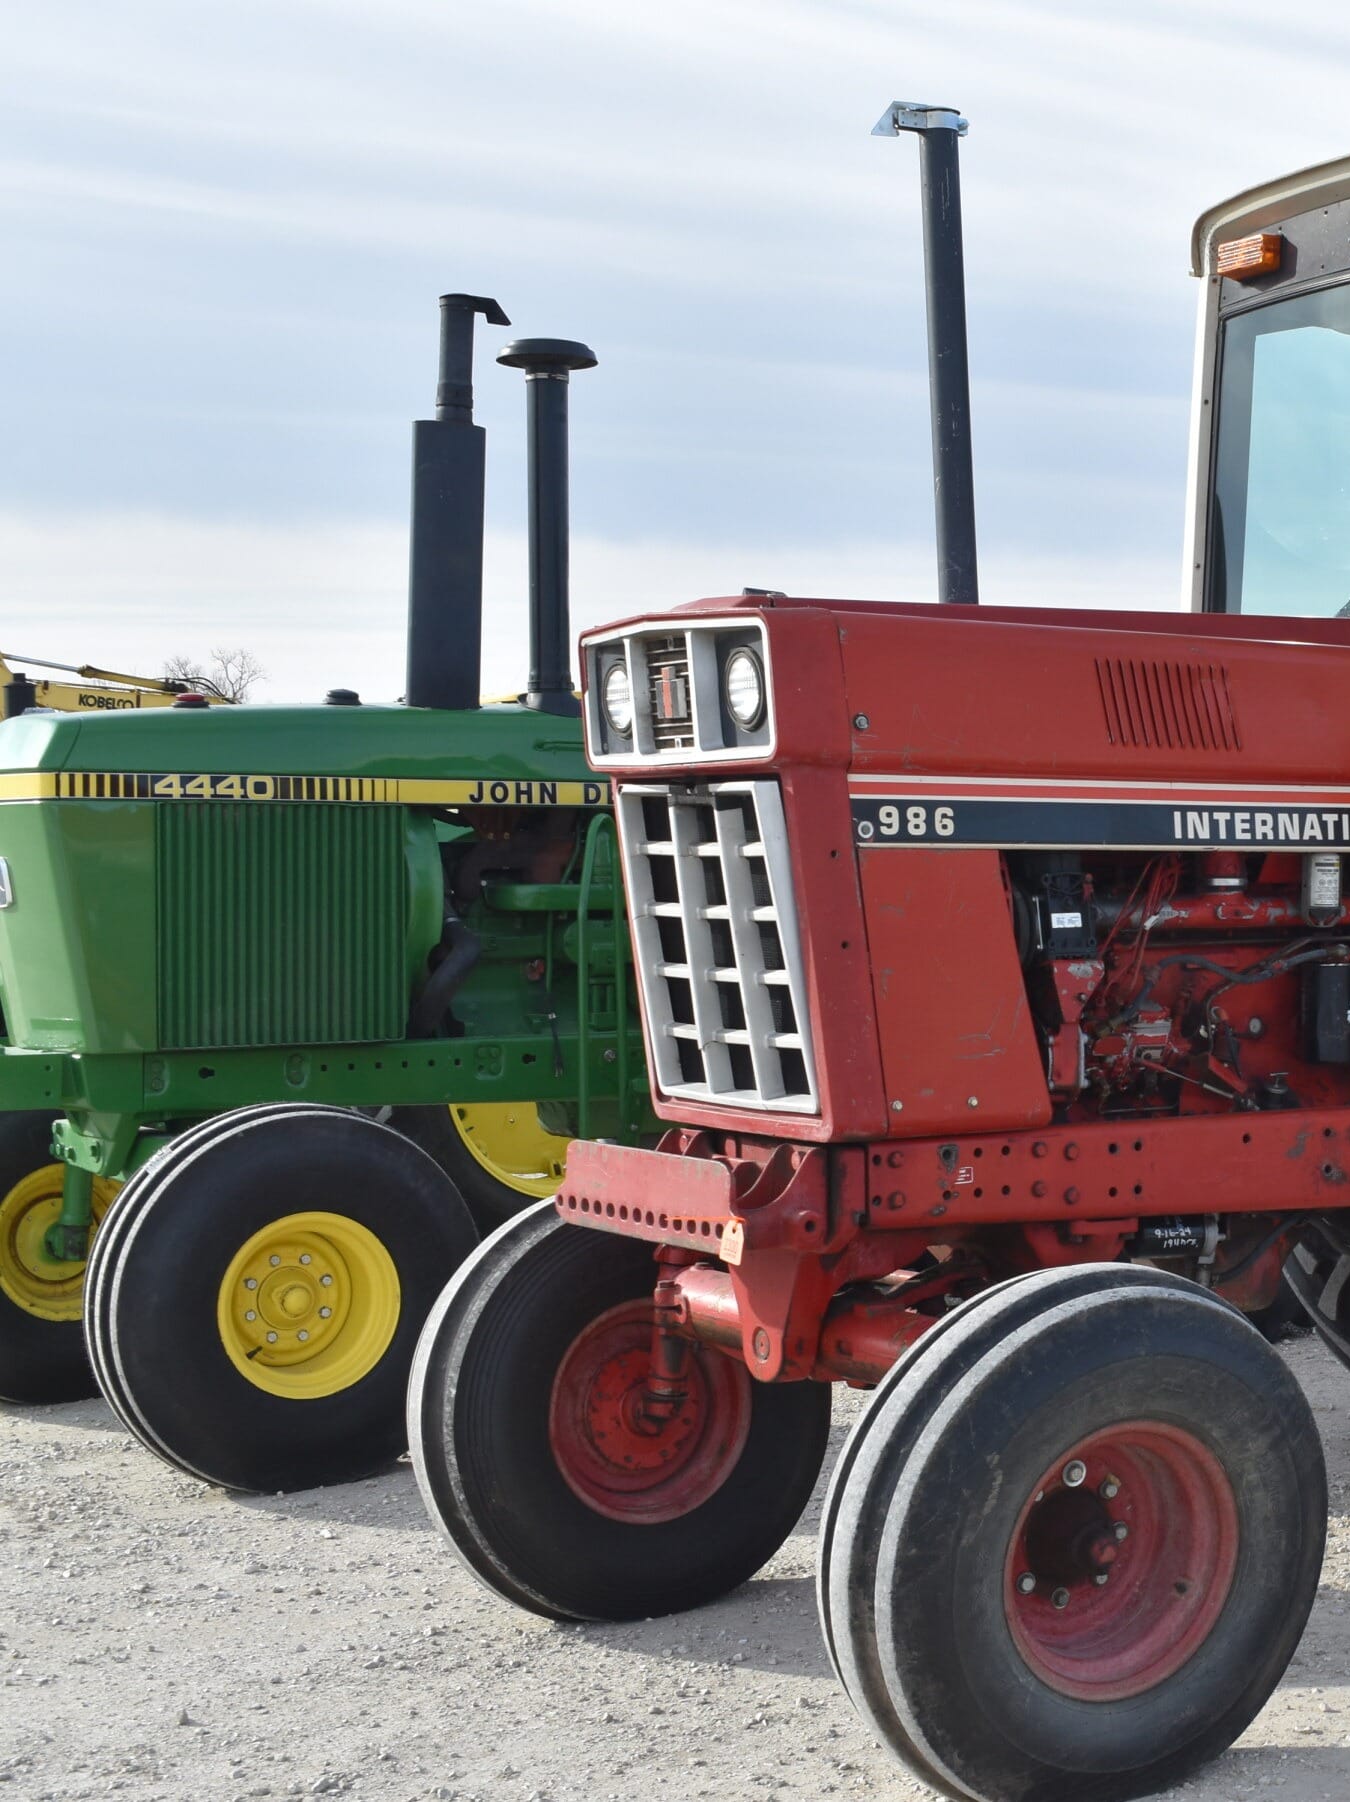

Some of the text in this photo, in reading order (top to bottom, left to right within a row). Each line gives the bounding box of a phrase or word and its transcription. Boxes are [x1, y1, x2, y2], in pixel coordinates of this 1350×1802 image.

[154, 774, 275, 800] 4440
[469, 781, 557, 804] JOHN
[879, 805, 955, 836] 986
